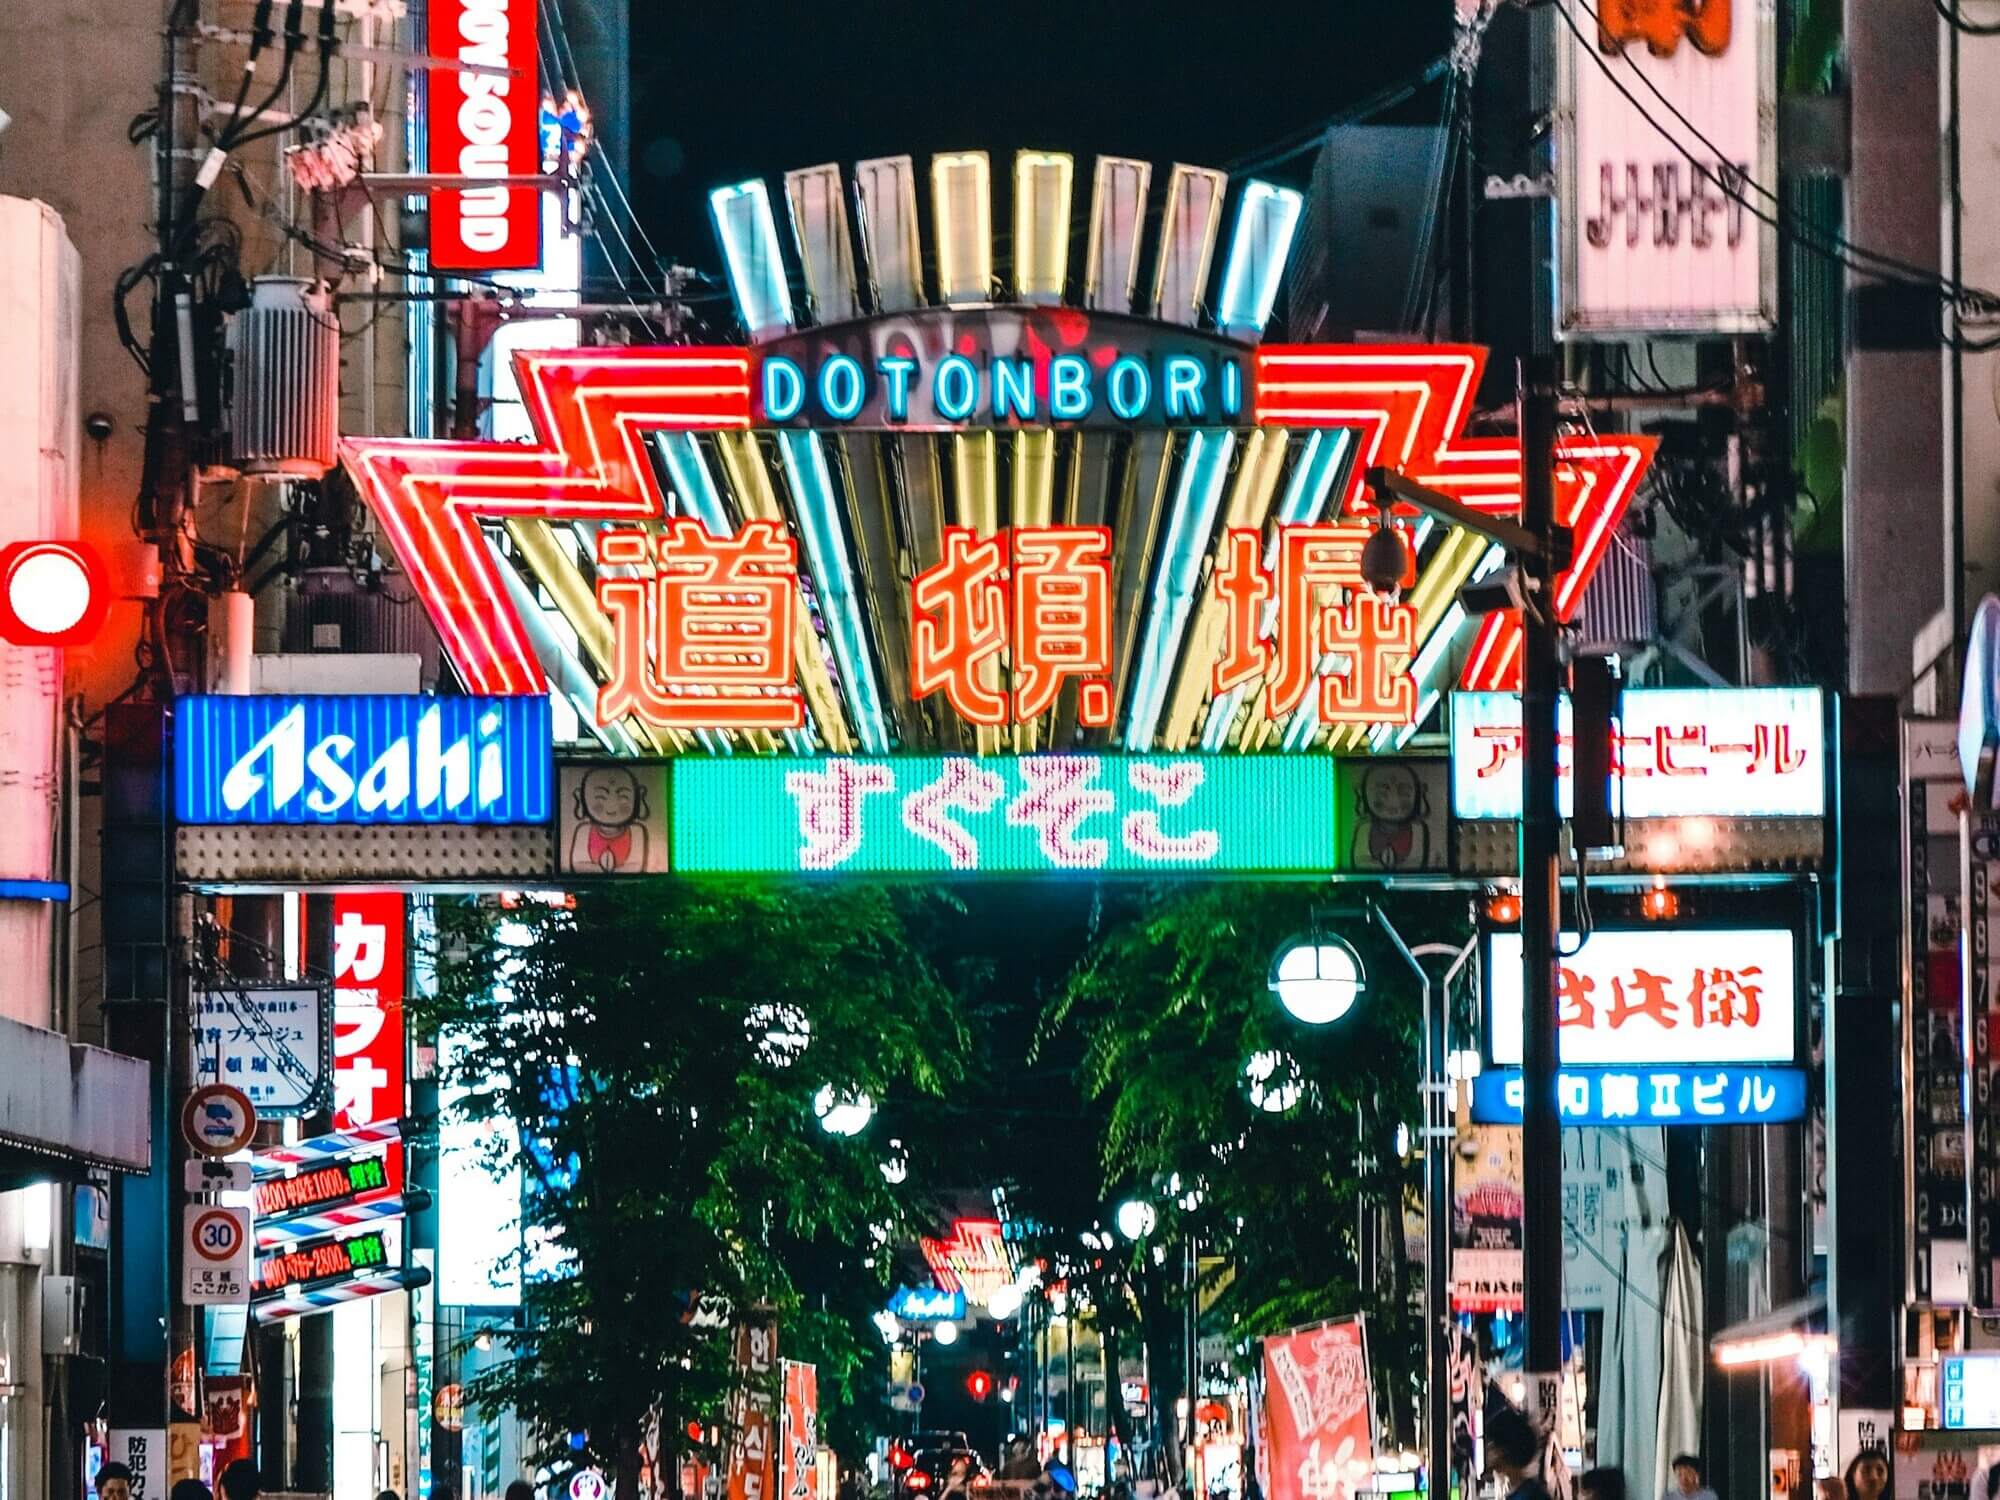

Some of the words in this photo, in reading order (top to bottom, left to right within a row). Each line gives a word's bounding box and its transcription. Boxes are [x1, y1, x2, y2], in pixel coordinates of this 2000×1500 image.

[457, 0, 511, 252] OYSOUND
[762, 355, 1241, 421] DOTONBORI
[596, 518, 1419, 729] 道頓堀
[222, 703, 504, 812] Asahi
[1473, 724, 1806, 778] アヒビール
[785, 757, 1219, 870] すぐそこ
[1975, 920, 1986, 957] 8
[1976, 968, 1987, 1005] 7
[335, 912, 388, 1160] カラオ
[1976, 1014, 1988, 1055] 6
[204, 1224, 232, 1248] 30
[192, 1283, 241, 1295] ここから
[1918, 1249, 1928, 1294] 1
